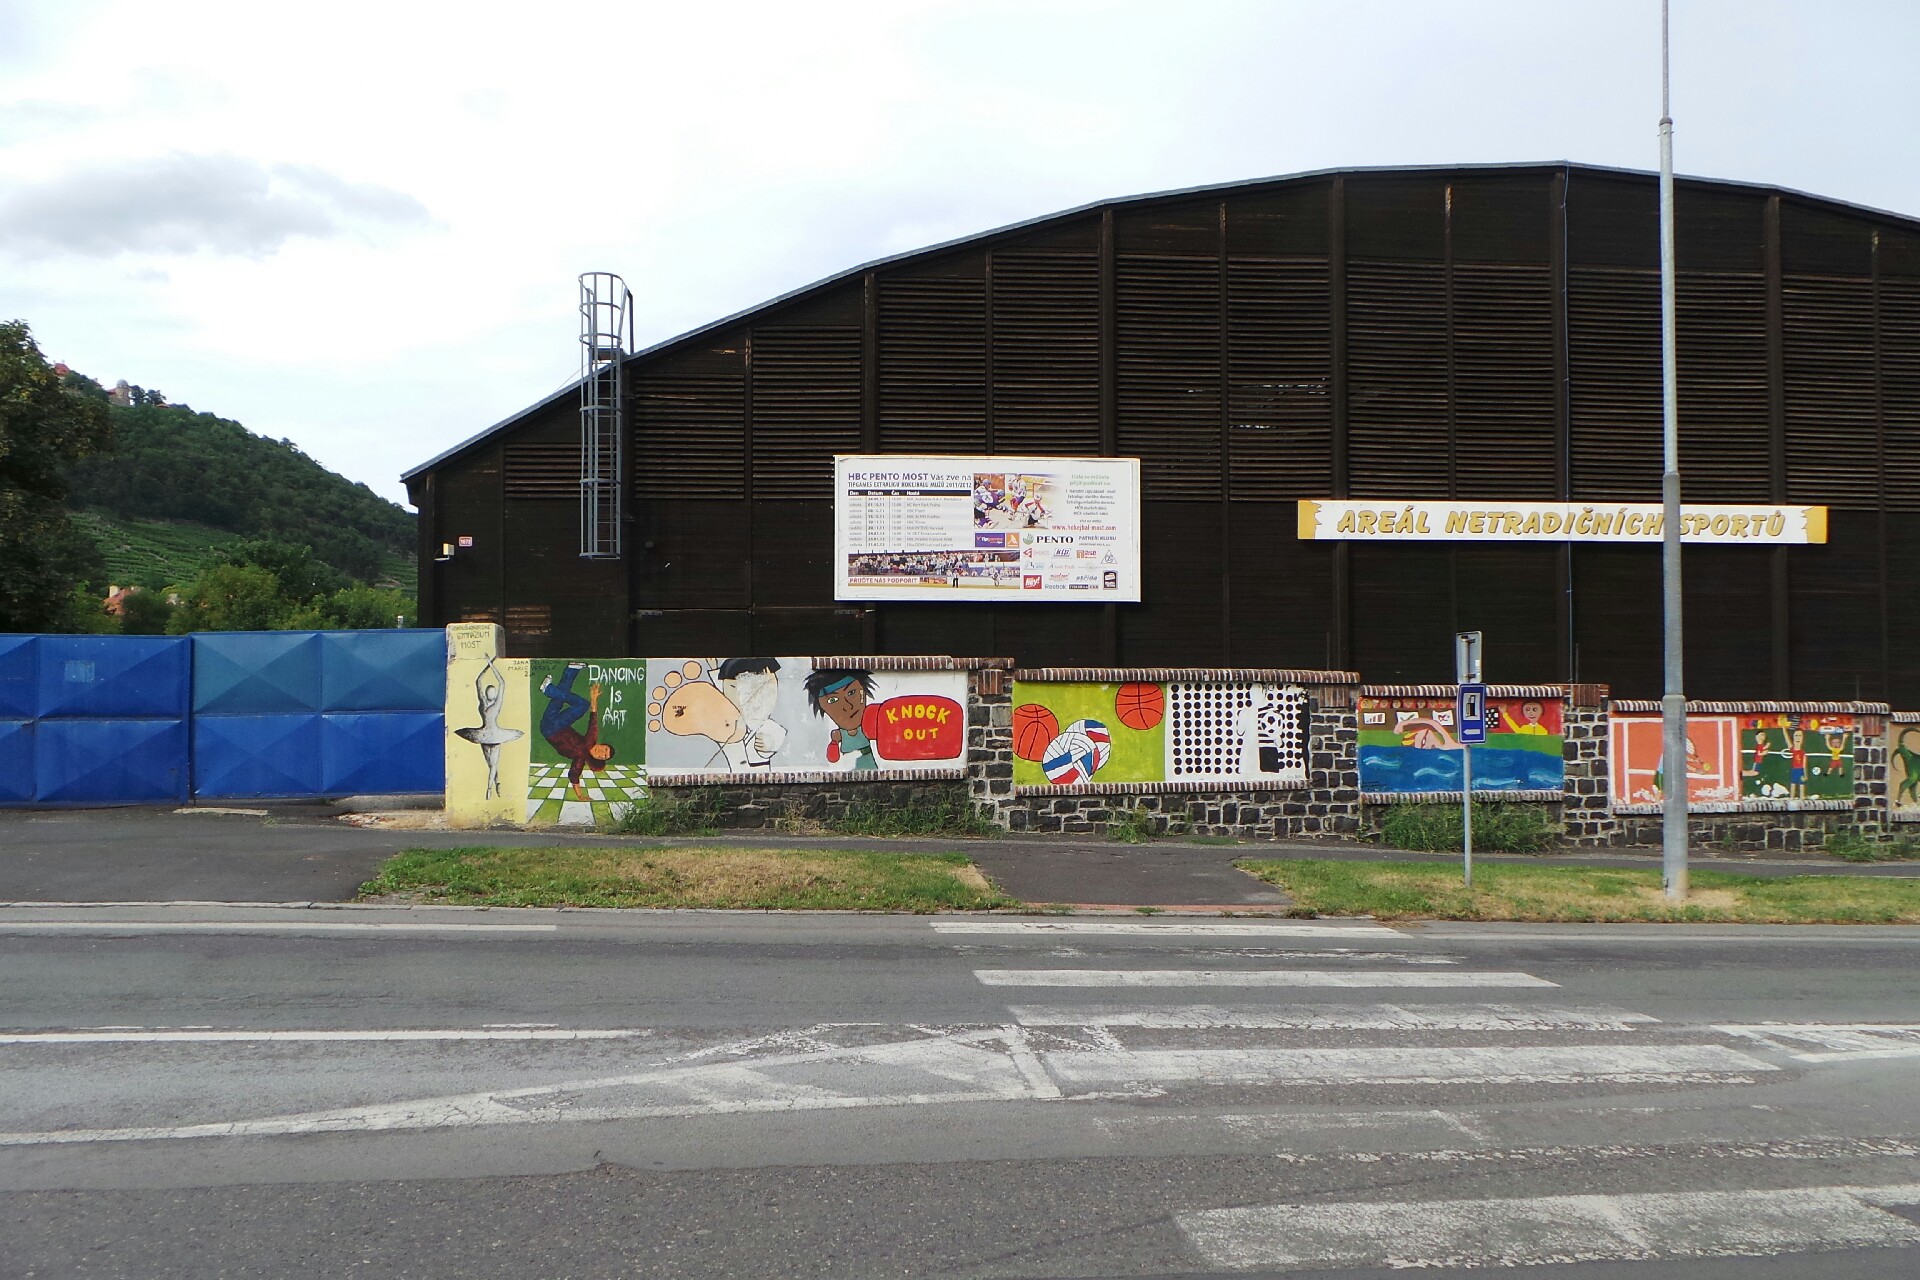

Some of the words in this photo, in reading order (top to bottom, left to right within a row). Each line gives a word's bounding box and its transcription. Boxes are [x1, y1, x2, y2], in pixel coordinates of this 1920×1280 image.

[848, 472, 867, 480] HBC
[869, 472, 900, 480] PENTO
[902, 472, 928, 480] MOST
[1337, 505, 1430, 535] AREÁL
[1444, 506, 1664, 536] NETRADIČNÍCH
[1680, 510, 1786, 538] SPORTŮ
[1036, 536, 1074, 544] PENTO
[460, 640, 482, 649] MOST
[588, 664, 645, 685] DANCING
[602, 708, 627, 728] ART
[886, 704, 950, 724] KNOCK
[904, 728, 938, 740] OUT
